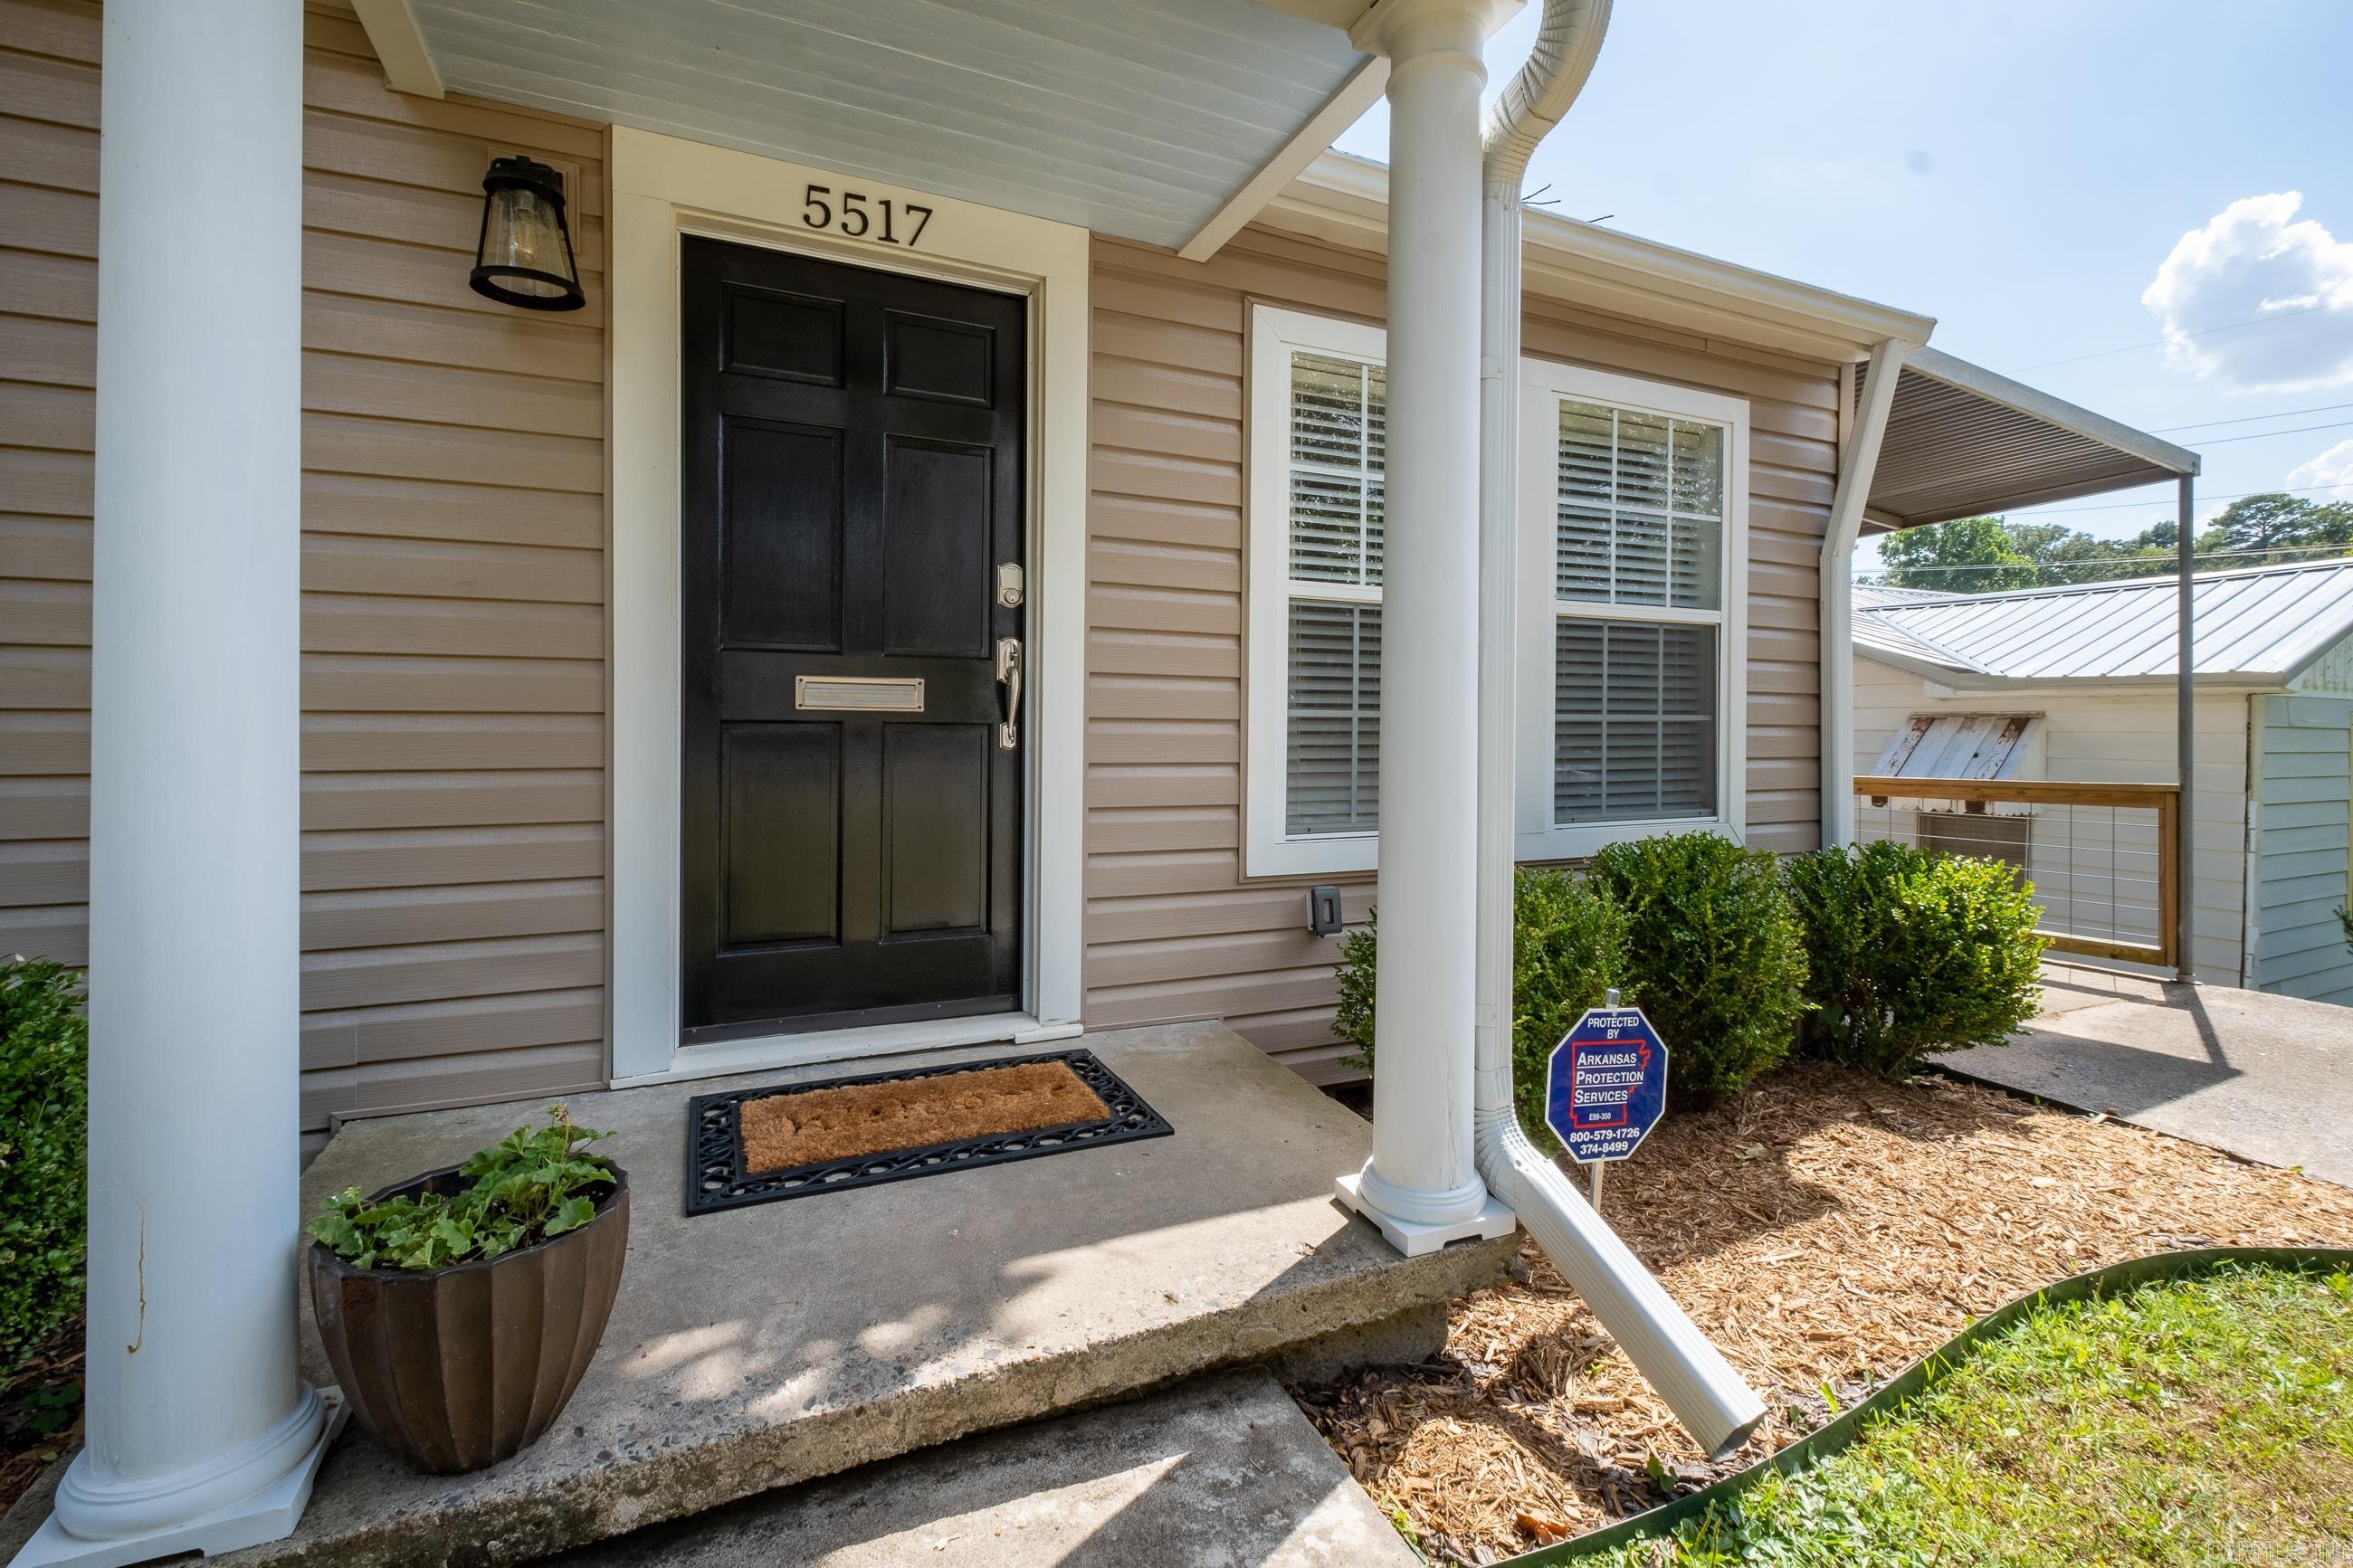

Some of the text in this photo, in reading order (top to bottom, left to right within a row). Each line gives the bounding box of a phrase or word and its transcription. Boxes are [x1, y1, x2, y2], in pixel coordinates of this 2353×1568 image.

[803, 184, 933, 247] 5517
[1587, 1017, 1639, 1028] PROTECTED
[1607, 1029, 1620, 1040] BY
[1577, 1052, 1637, 1066] ARKANSAS
[1576, 1070, 1643, 1085] PROTECTION
[1574, 1089, 1629, 1104] SERVICES
[1569, 1127, 1641, 1143] 800-579-1726
[1579, 1142, 1629, 1155] 374-8499
